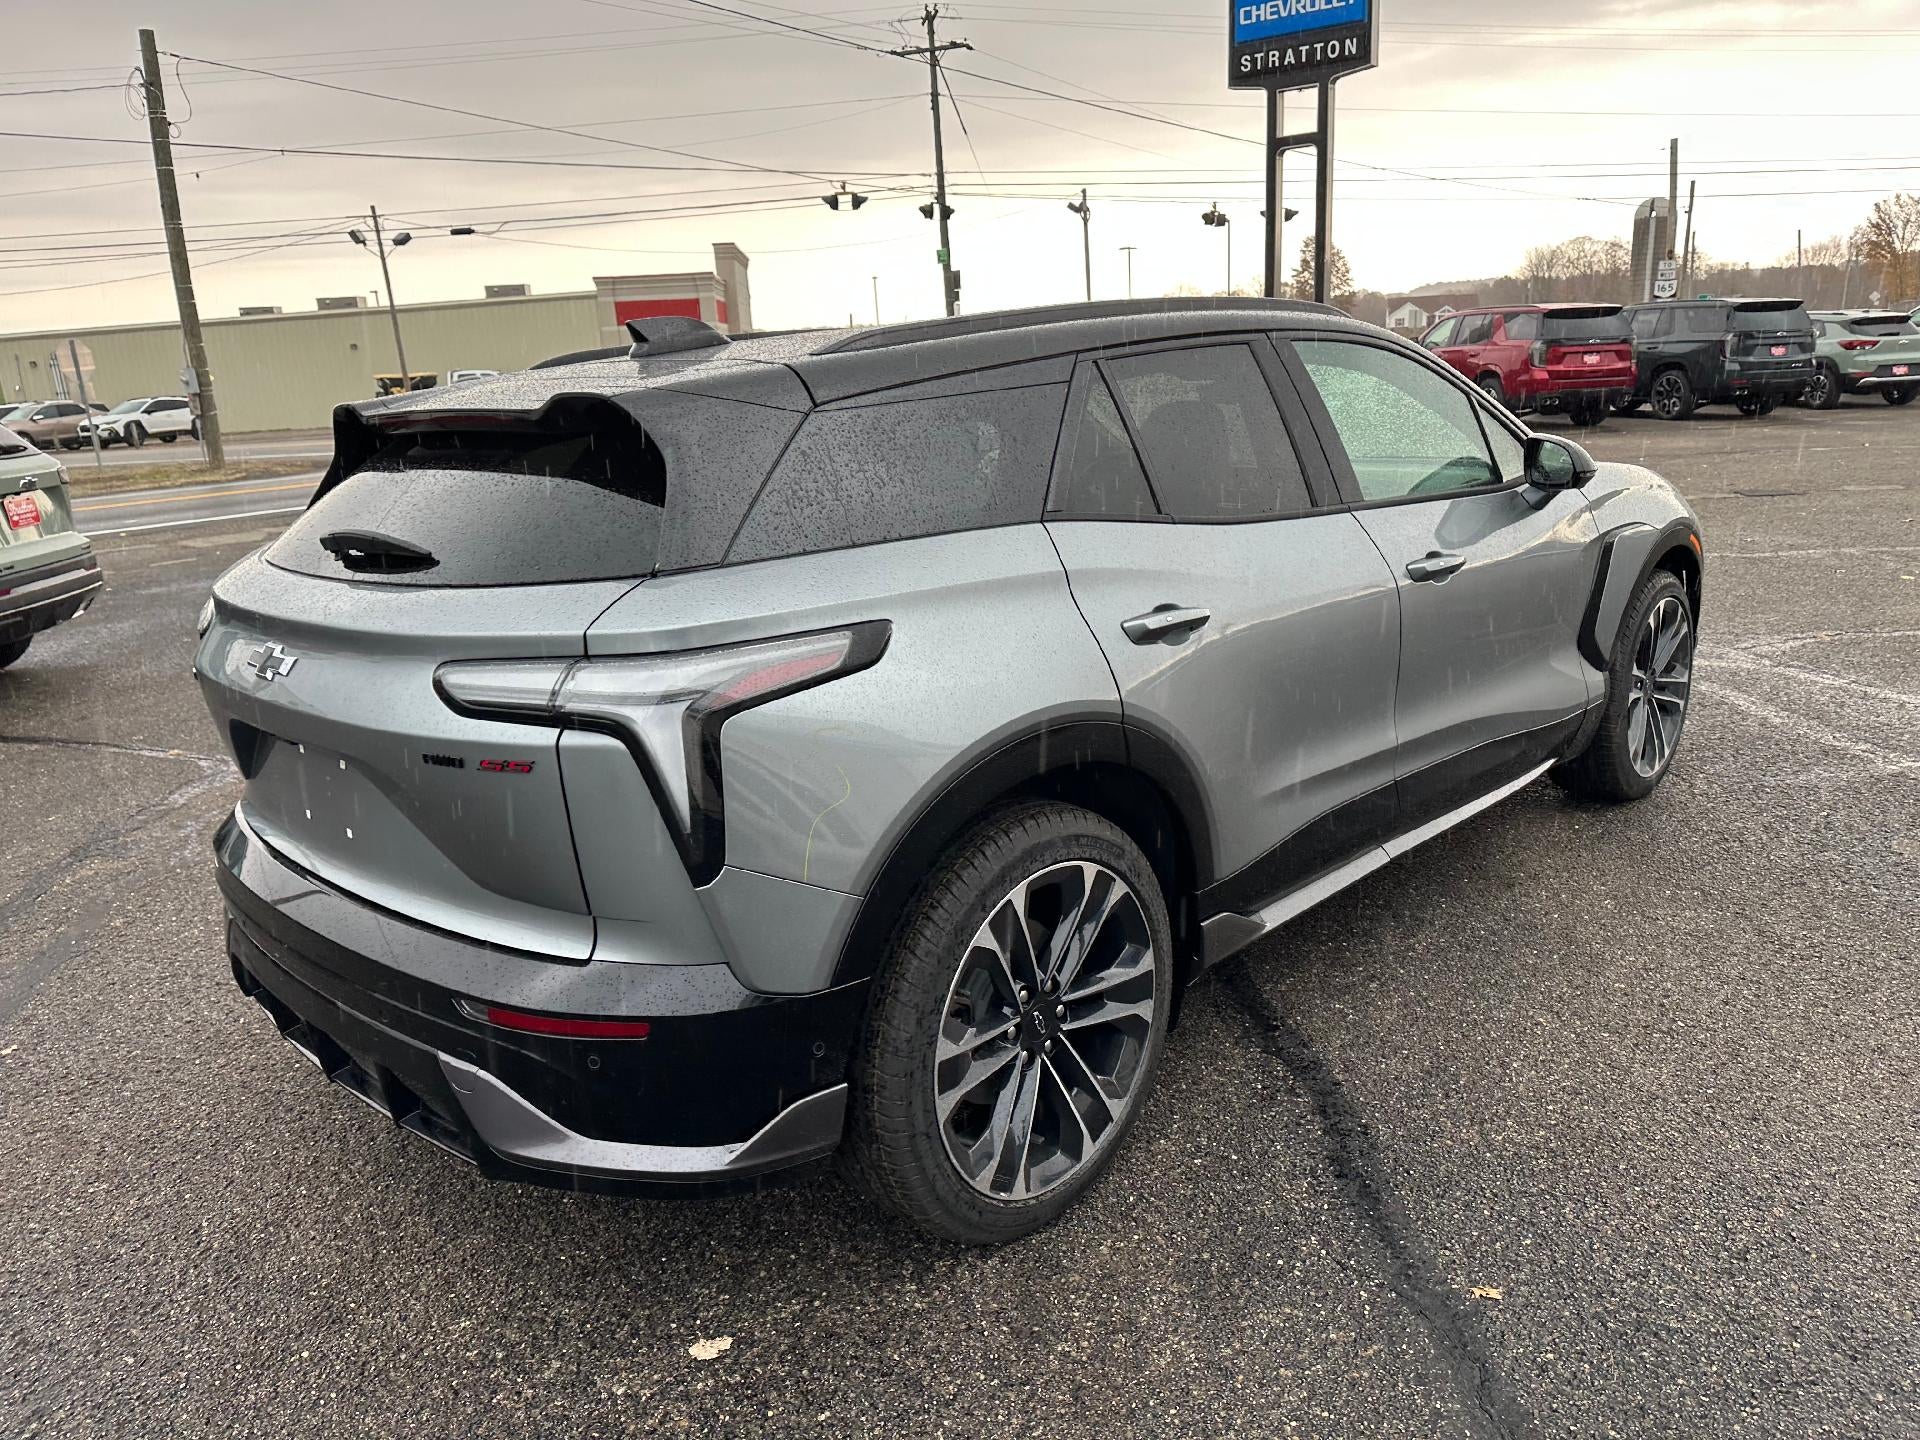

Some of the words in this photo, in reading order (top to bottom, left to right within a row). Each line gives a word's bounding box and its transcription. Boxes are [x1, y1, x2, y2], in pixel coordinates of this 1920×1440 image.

[1239, 0, 1354, 25] CHEVROL
[1240, 37, 1357, 72] STRATTON
[1657, 283, 1674, 293] 165
[479, 759, 535, 773] SS
